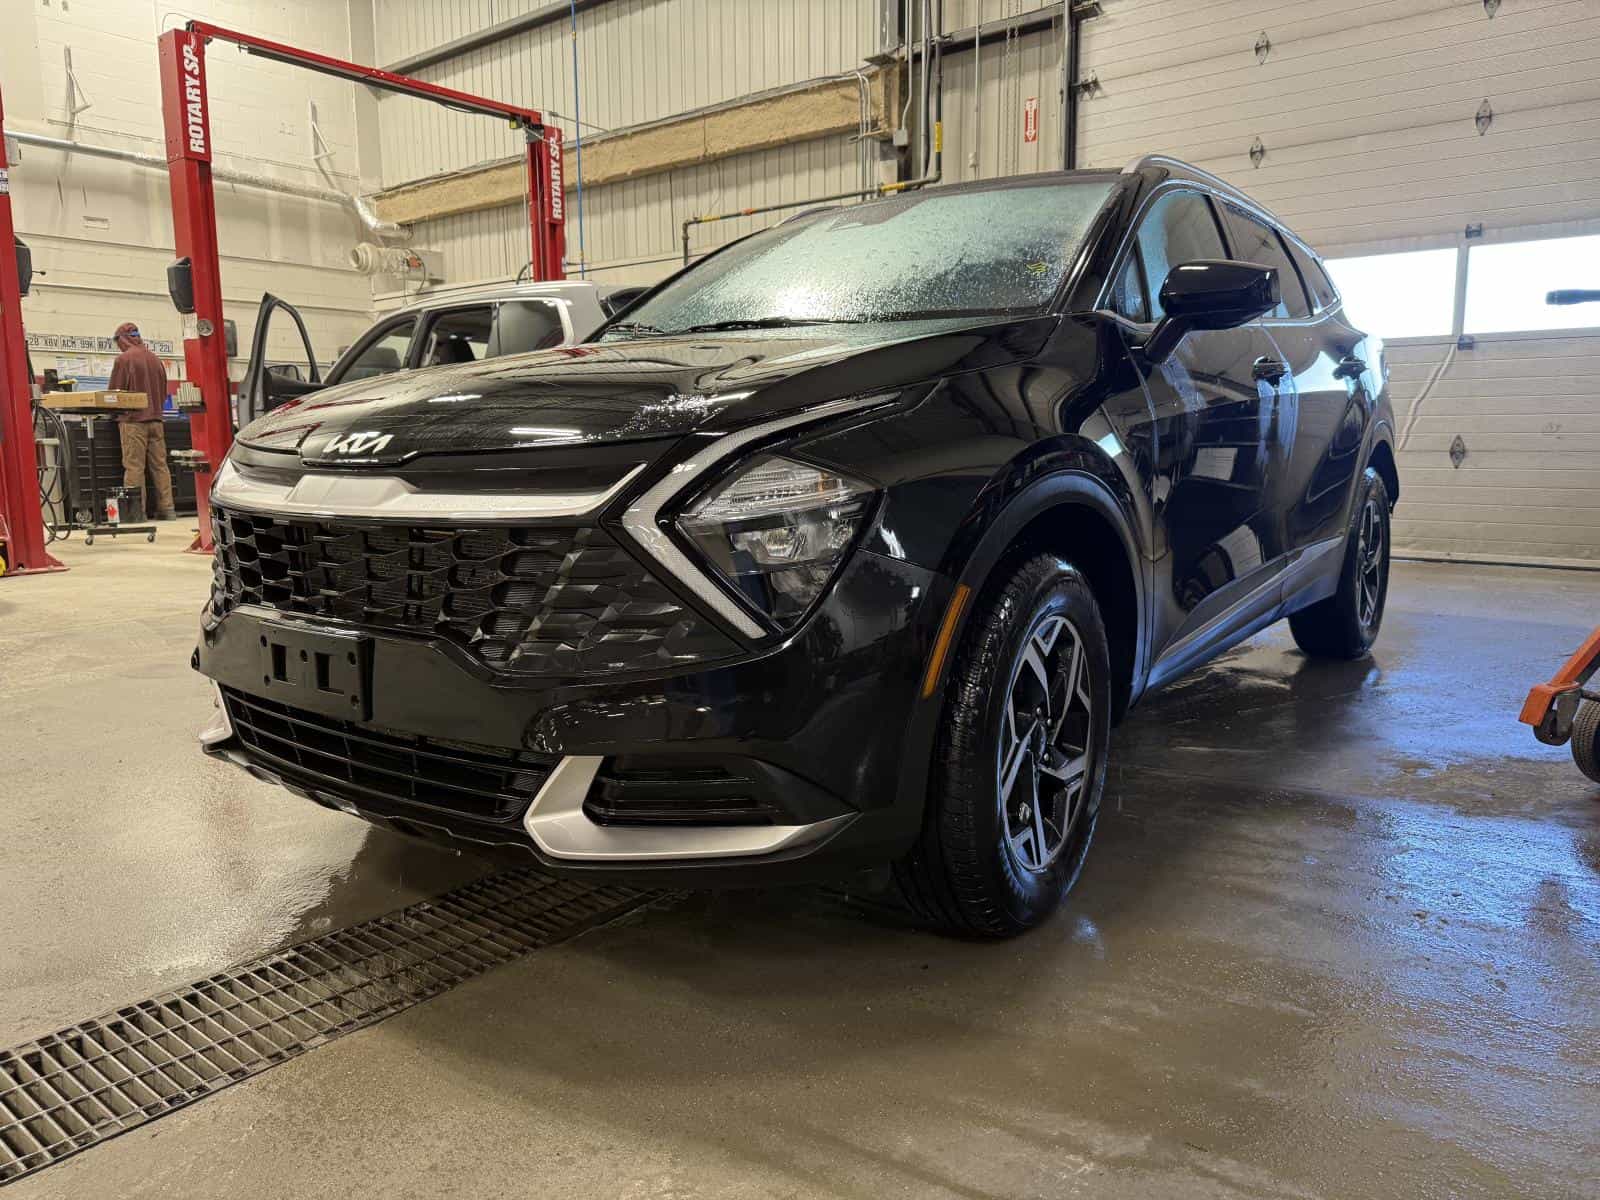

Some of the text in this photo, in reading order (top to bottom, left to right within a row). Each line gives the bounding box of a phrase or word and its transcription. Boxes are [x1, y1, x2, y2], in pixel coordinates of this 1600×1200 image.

[185, 74, 205, 153] ROTARY
[551, 159, 562, 220] ROTARY
[322, 432, 395, 455] KIA
